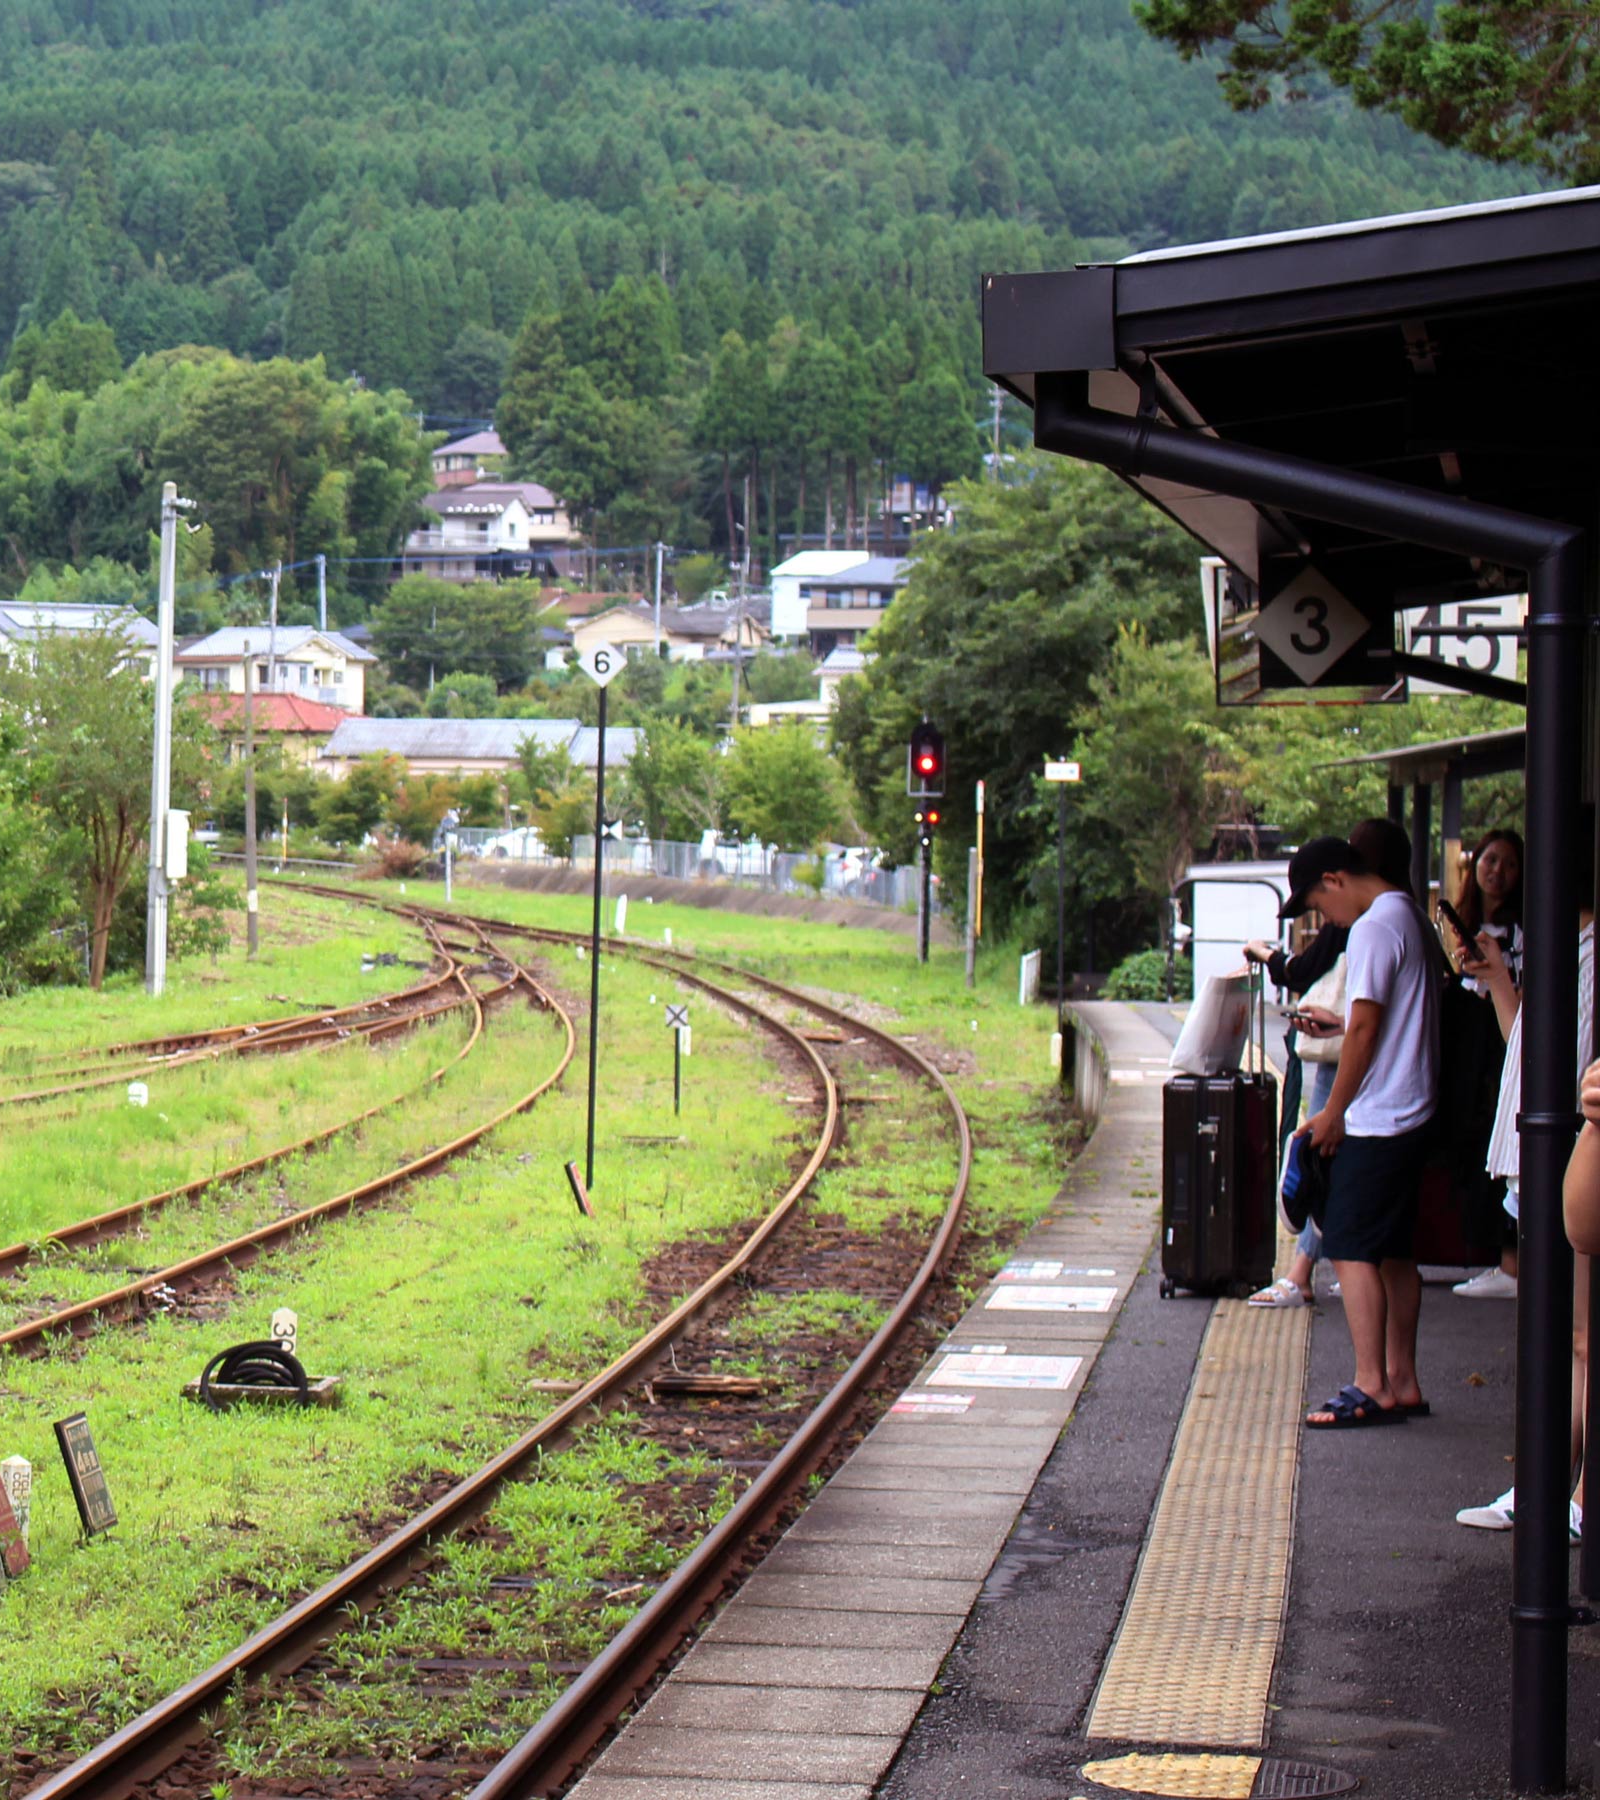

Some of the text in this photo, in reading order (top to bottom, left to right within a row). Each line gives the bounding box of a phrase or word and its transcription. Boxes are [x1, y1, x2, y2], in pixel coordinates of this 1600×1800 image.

[1289, 596, 1332, 655] 3
[1411, 603, 1502, 675] 45
[595, 650, 610, 674] 6
